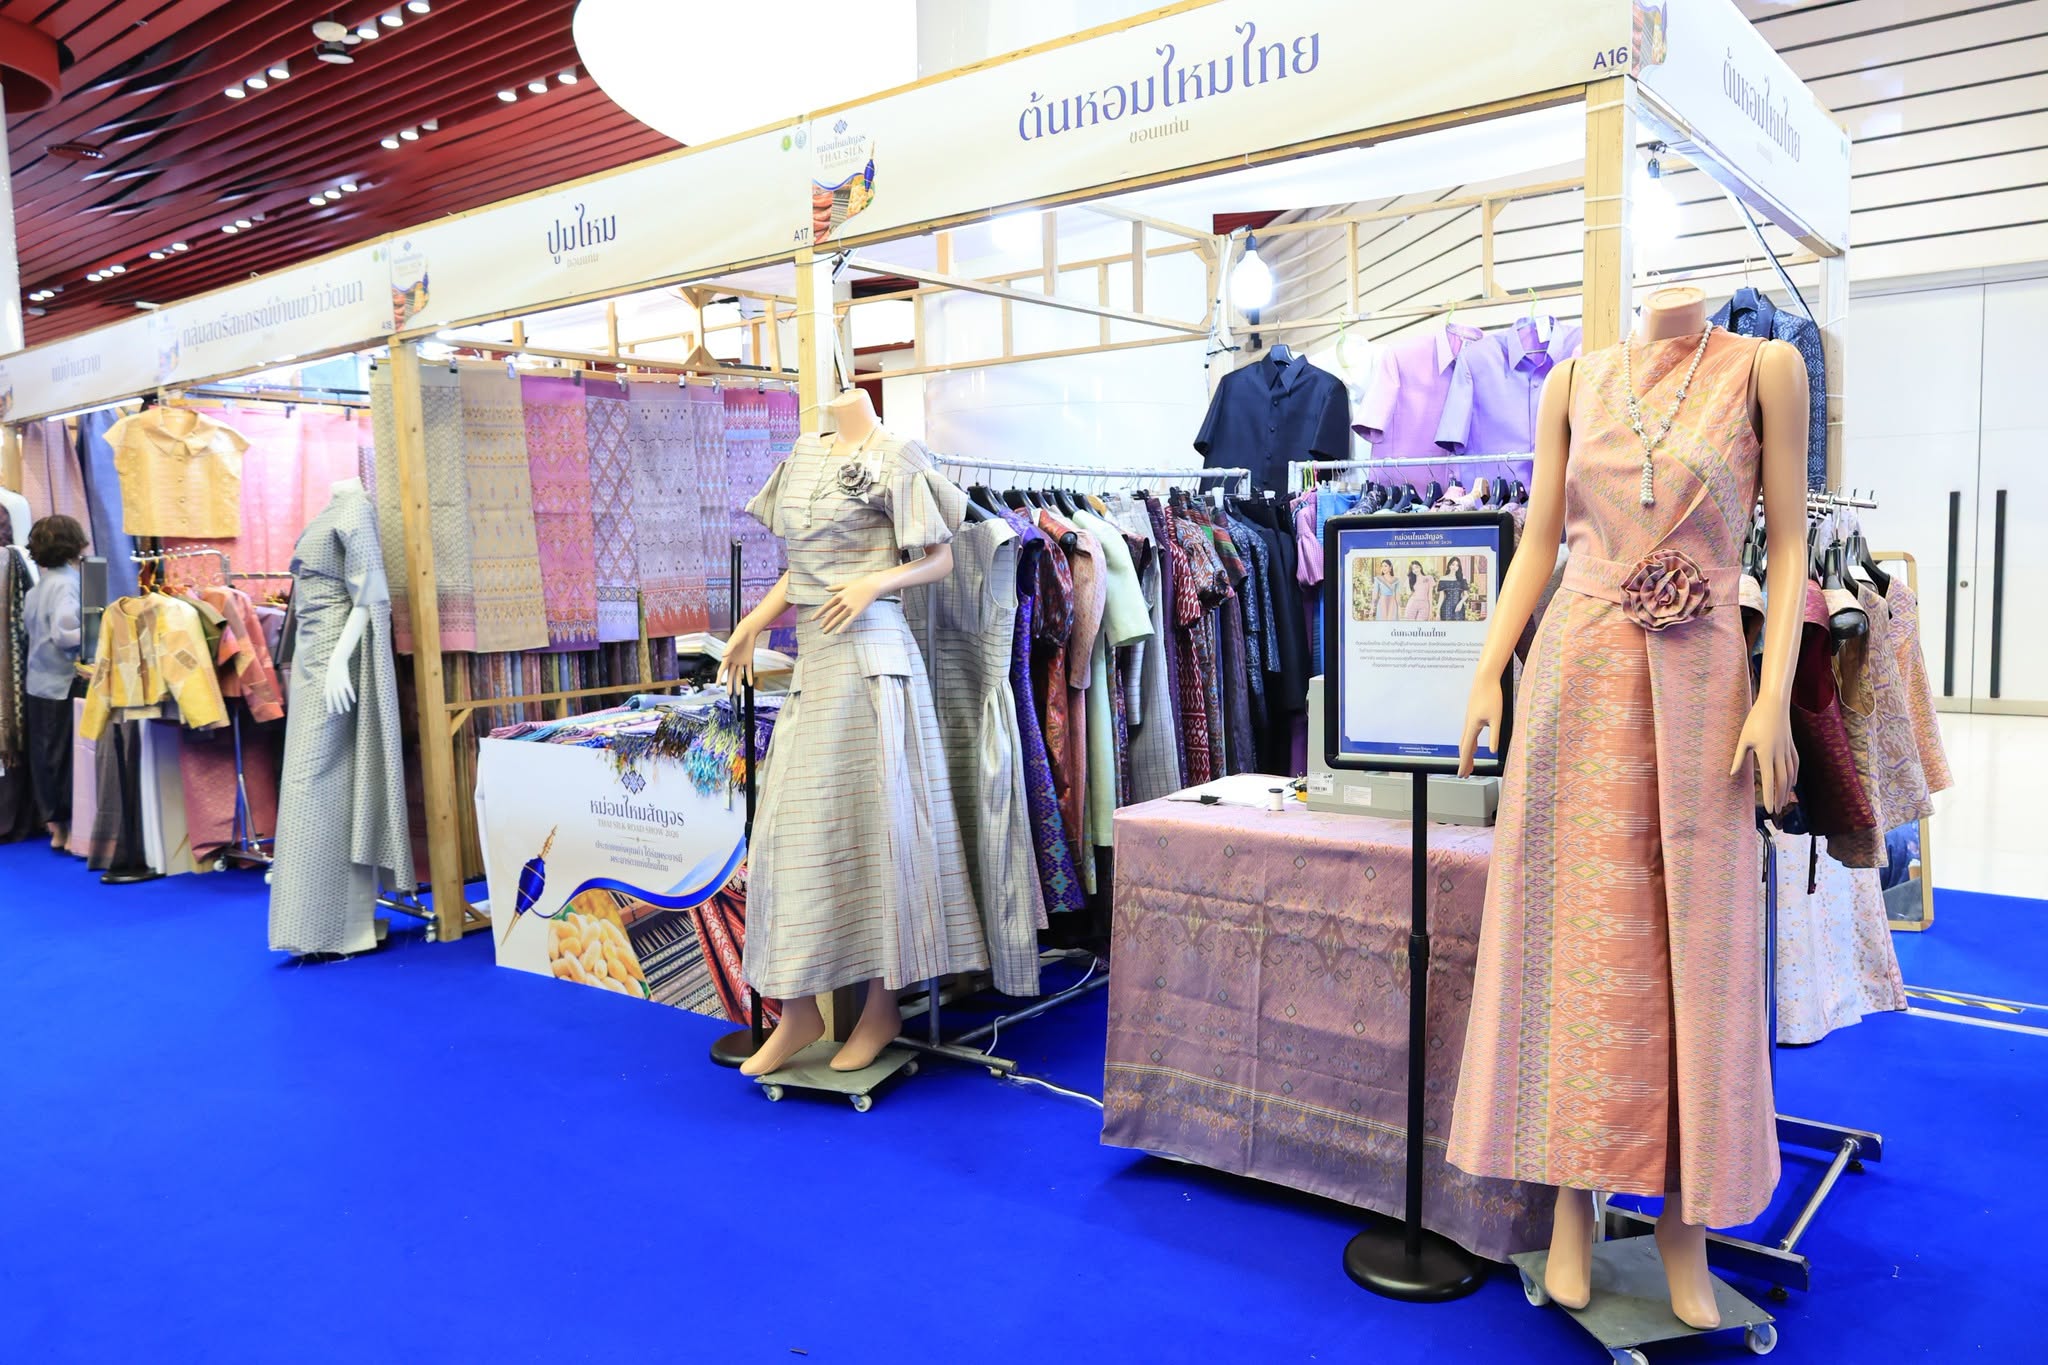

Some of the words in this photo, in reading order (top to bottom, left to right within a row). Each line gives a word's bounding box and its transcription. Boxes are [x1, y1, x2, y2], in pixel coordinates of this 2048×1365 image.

[1593, 46, 1629, 70] A16
[1018, 21, 1320, 142] ต้นหอมไหมไทย
[1722, 46, 1801, 163] ต้นหอมไหมไทย
[1129, 115, 1190, 145] ขอนแก่น
[547, 202, 616, 265] ปูมไหม
[793, 227, 809, 243] A17
[590, 794, 685, 828] หม่อนไหมสัญจร
[613, 821, 627, 831] SILK
[627, 823, 645, 833] ROAD
